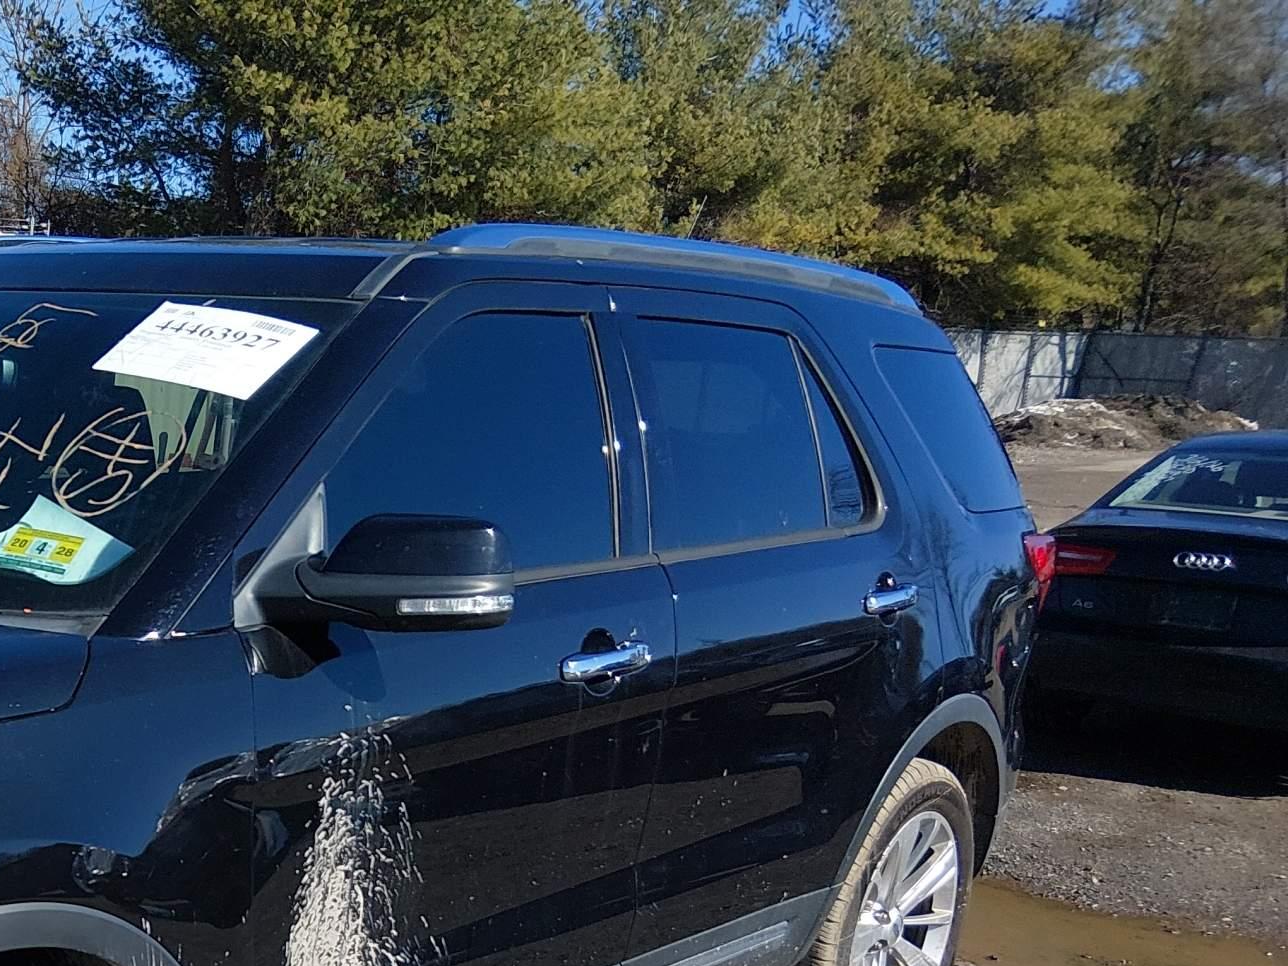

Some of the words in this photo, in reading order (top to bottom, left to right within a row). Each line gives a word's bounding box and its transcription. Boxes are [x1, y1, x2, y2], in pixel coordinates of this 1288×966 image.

[155, 319, 281, 350] 44463927
[10, 537, 28, 549] 20
[35, 541, 49, 555] 4
[55, 546, 74, 557] 28
[1071, 599, 1094, 609] A6
